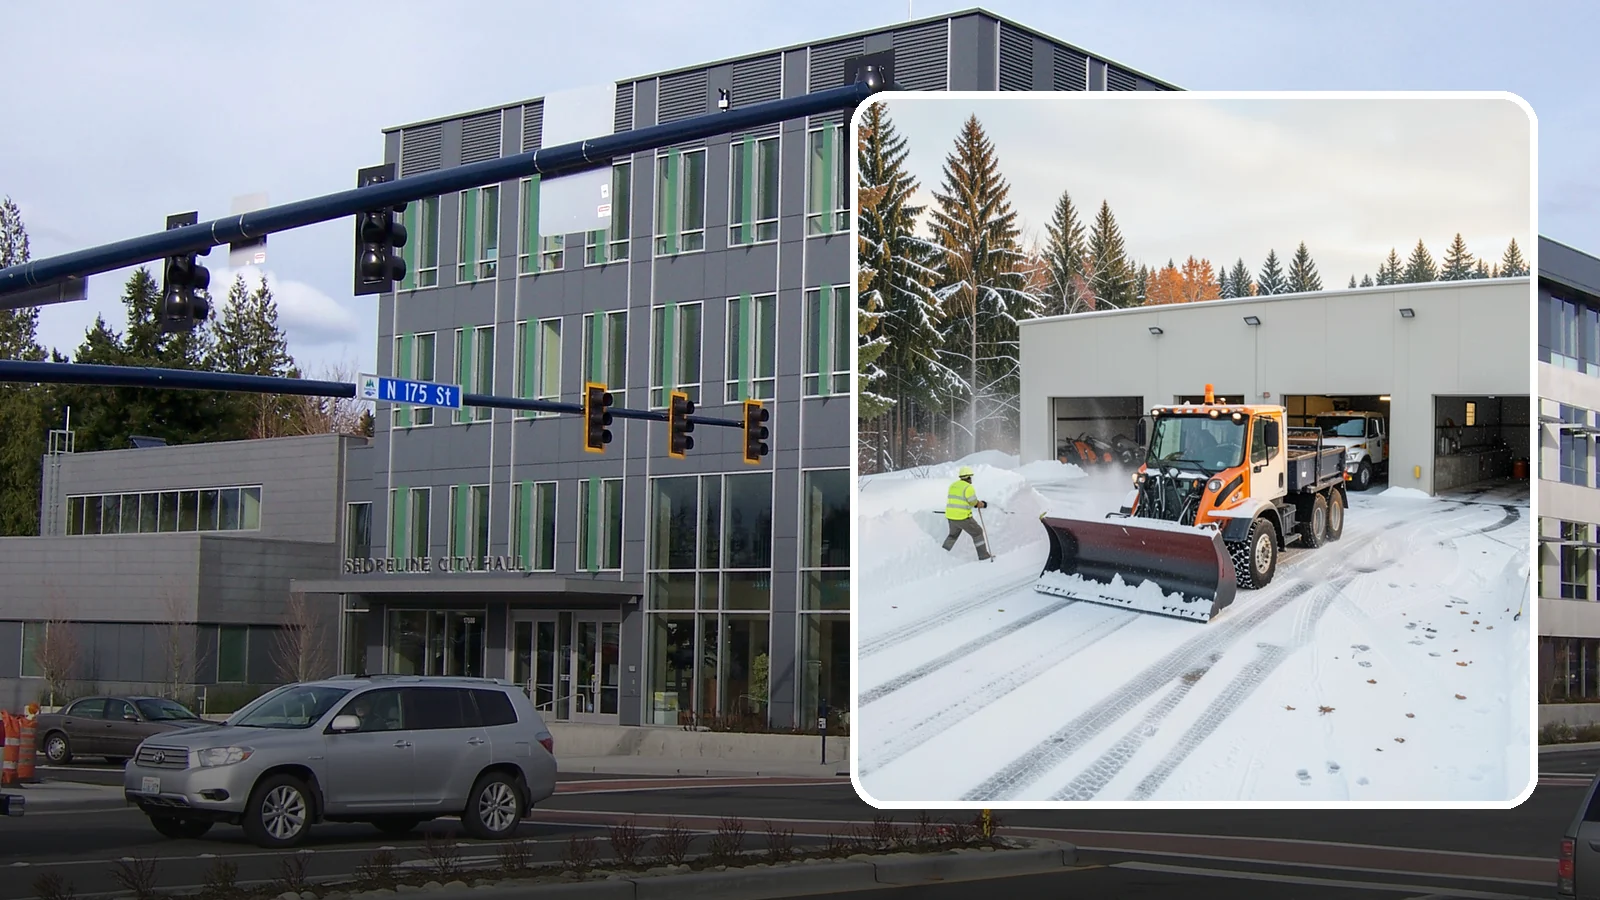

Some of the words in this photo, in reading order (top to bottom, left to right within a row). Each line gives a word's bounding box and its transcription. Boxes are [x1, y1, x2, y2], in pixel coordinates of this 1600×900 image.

[387, 381, 396, 399] N
[405, 383, 428, 403] 175
[436, 386, 451, 406] St
[344, 557, 432, 574] SHORELINE
[439, 556, 475, 572] CITY
[484, 556, 525, 571] HALL
